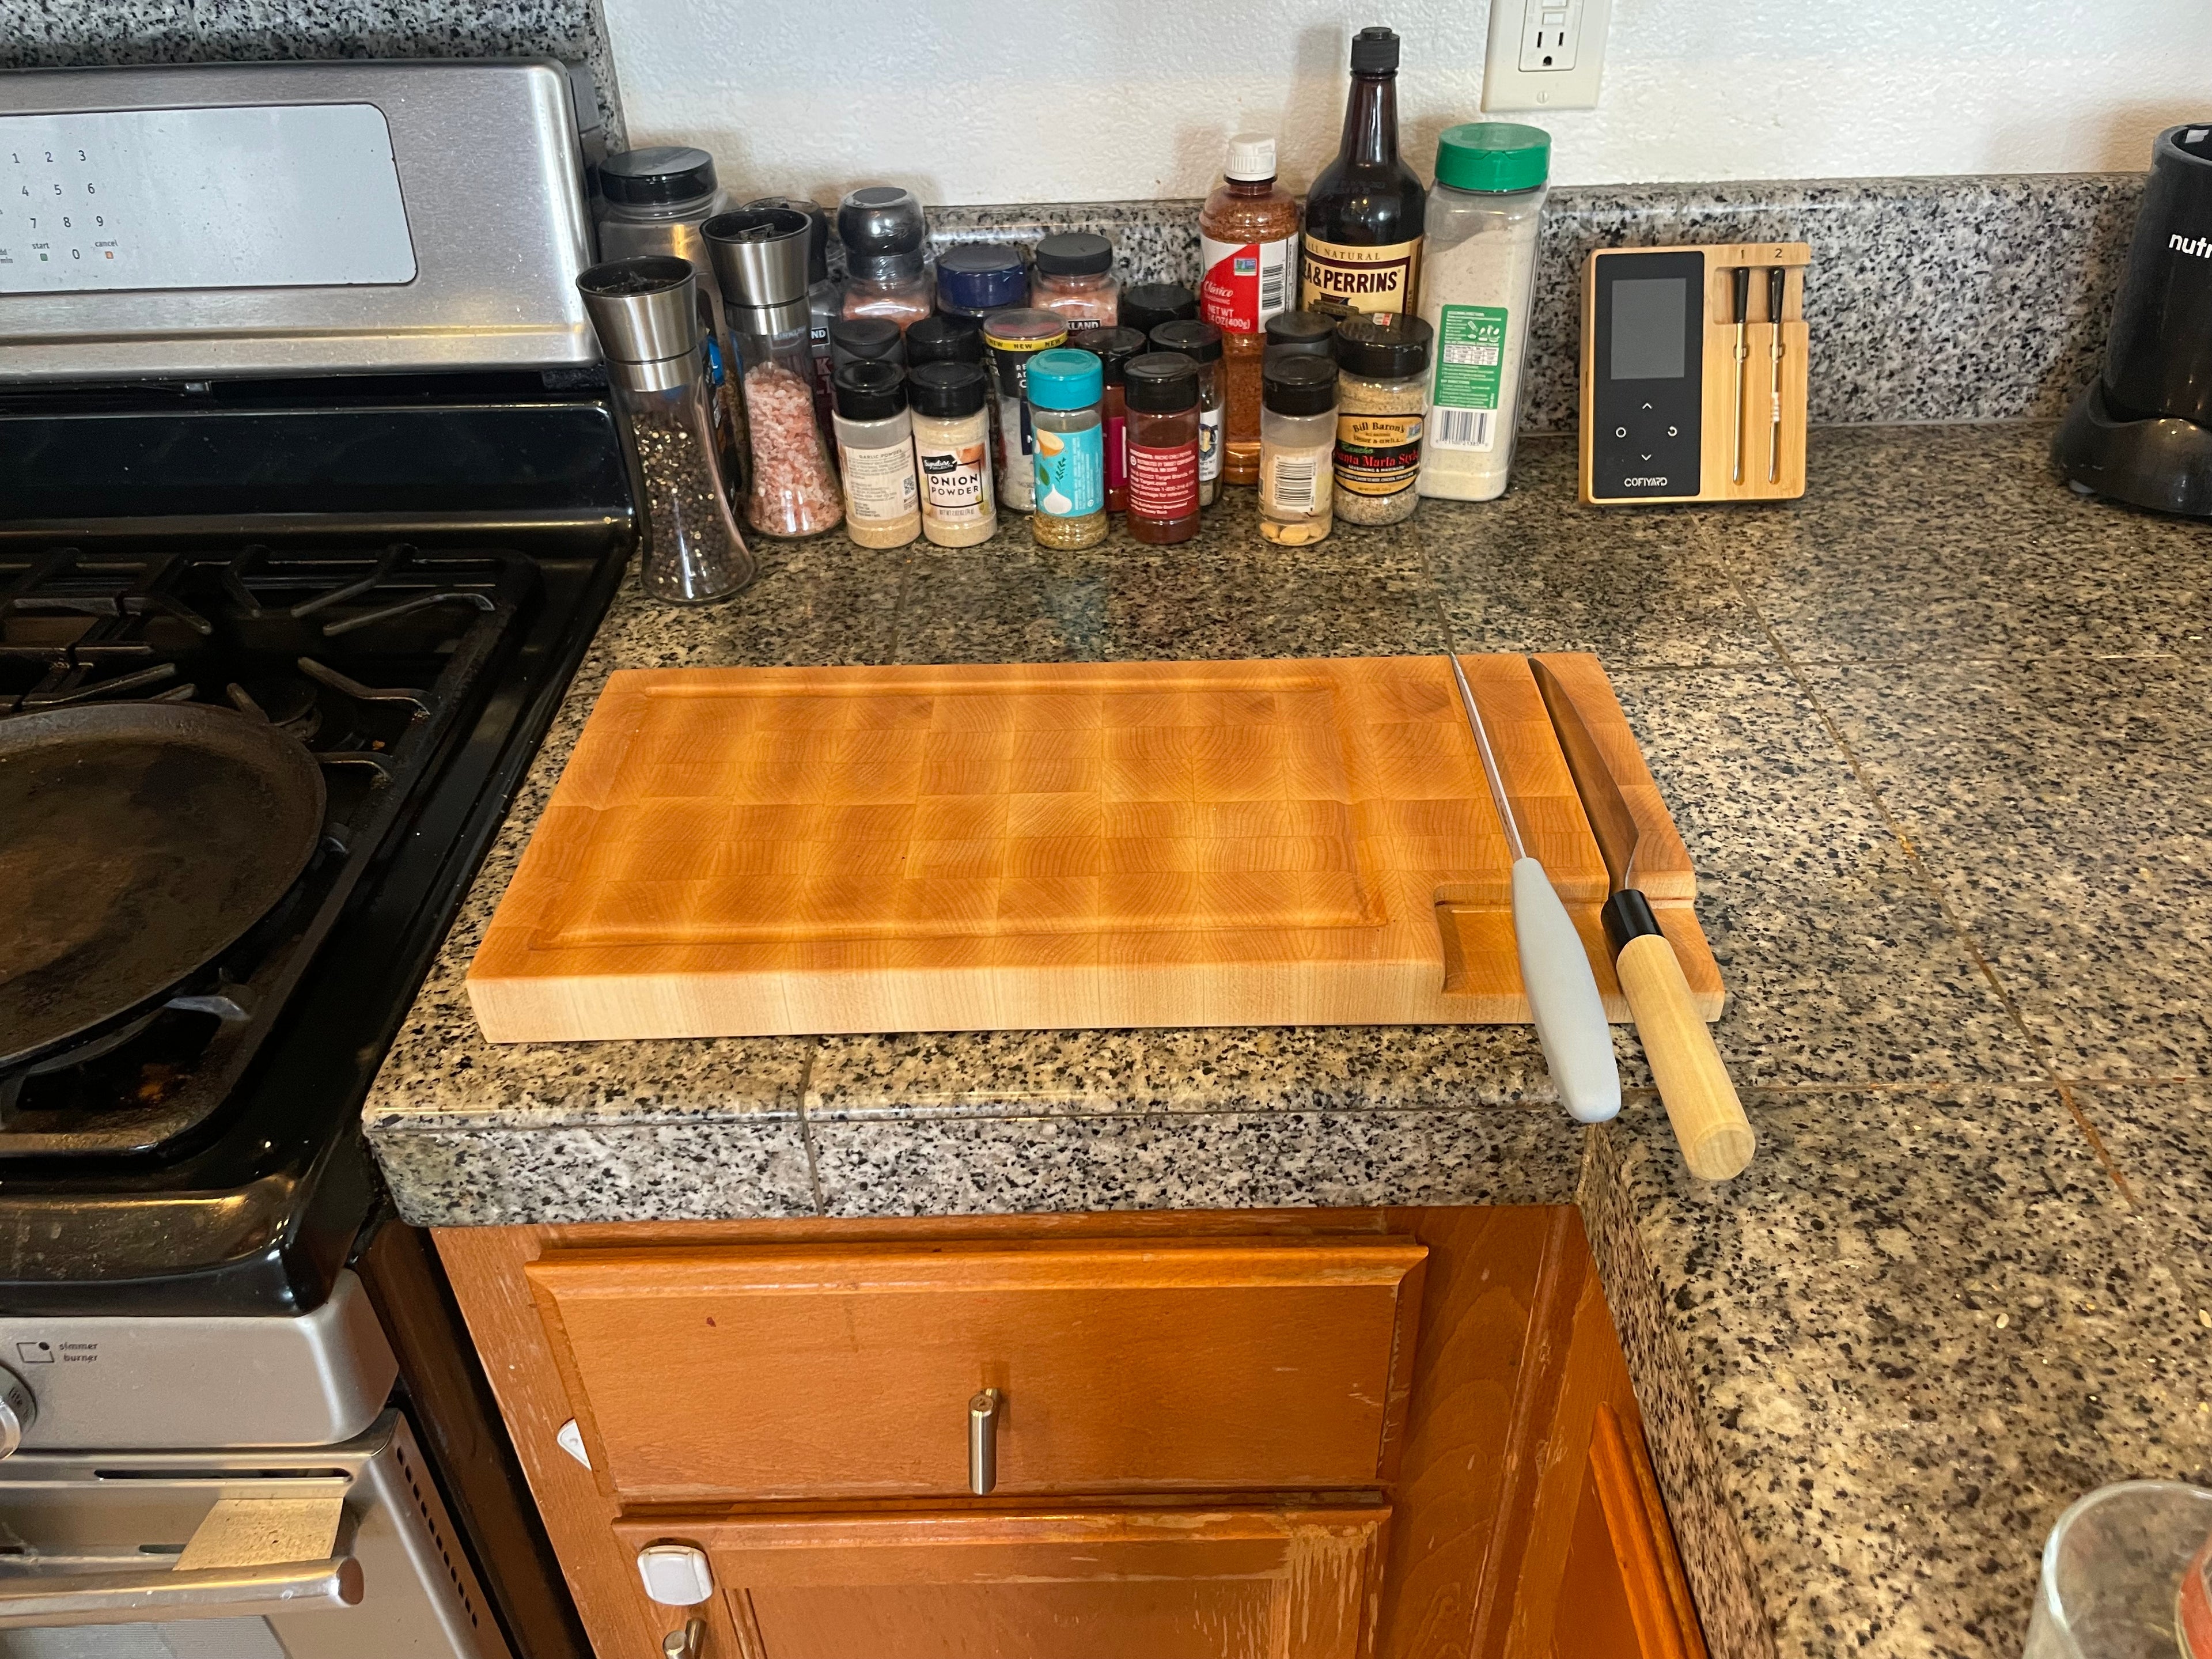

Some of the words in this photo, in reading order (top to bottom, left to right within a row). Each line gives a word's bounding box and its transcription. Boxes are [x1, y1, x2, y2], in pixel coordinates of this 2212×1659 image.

[12, 153, 20, 164] 1
[45, 151, 53, 162] 2
[78, 150, 86, 161] 3
[22, 185, 29, 196] 4
[54, 184, 62, 195] 5
[88, 183, 95, 194] 6
[30, 217, 36, 229] 7
[63, 217, 71, 228] 8
[96, 215, 104, 226] 9
[94, 239, 119, 247] cancel
[72, 248, 80, 259] 0
[1324, 248, 1381, 260] NATURAL
[1740, 249, 1745, 259] 1
[1775, 248, 1783, 259] 2
[1044, 338, 1061, 347] NEW
[1352, 422, 1369, 433] Bill
[1362, 455, 1396, 468] Maria
[930, 473, 978, 486] ONION
[1624, 476, 1668, 487] COFIYARD
[931, 485, 979, 496] POWDER
[59, 1342, 99, 1351] simmer
[63, 1354, 98, 1363] burner
